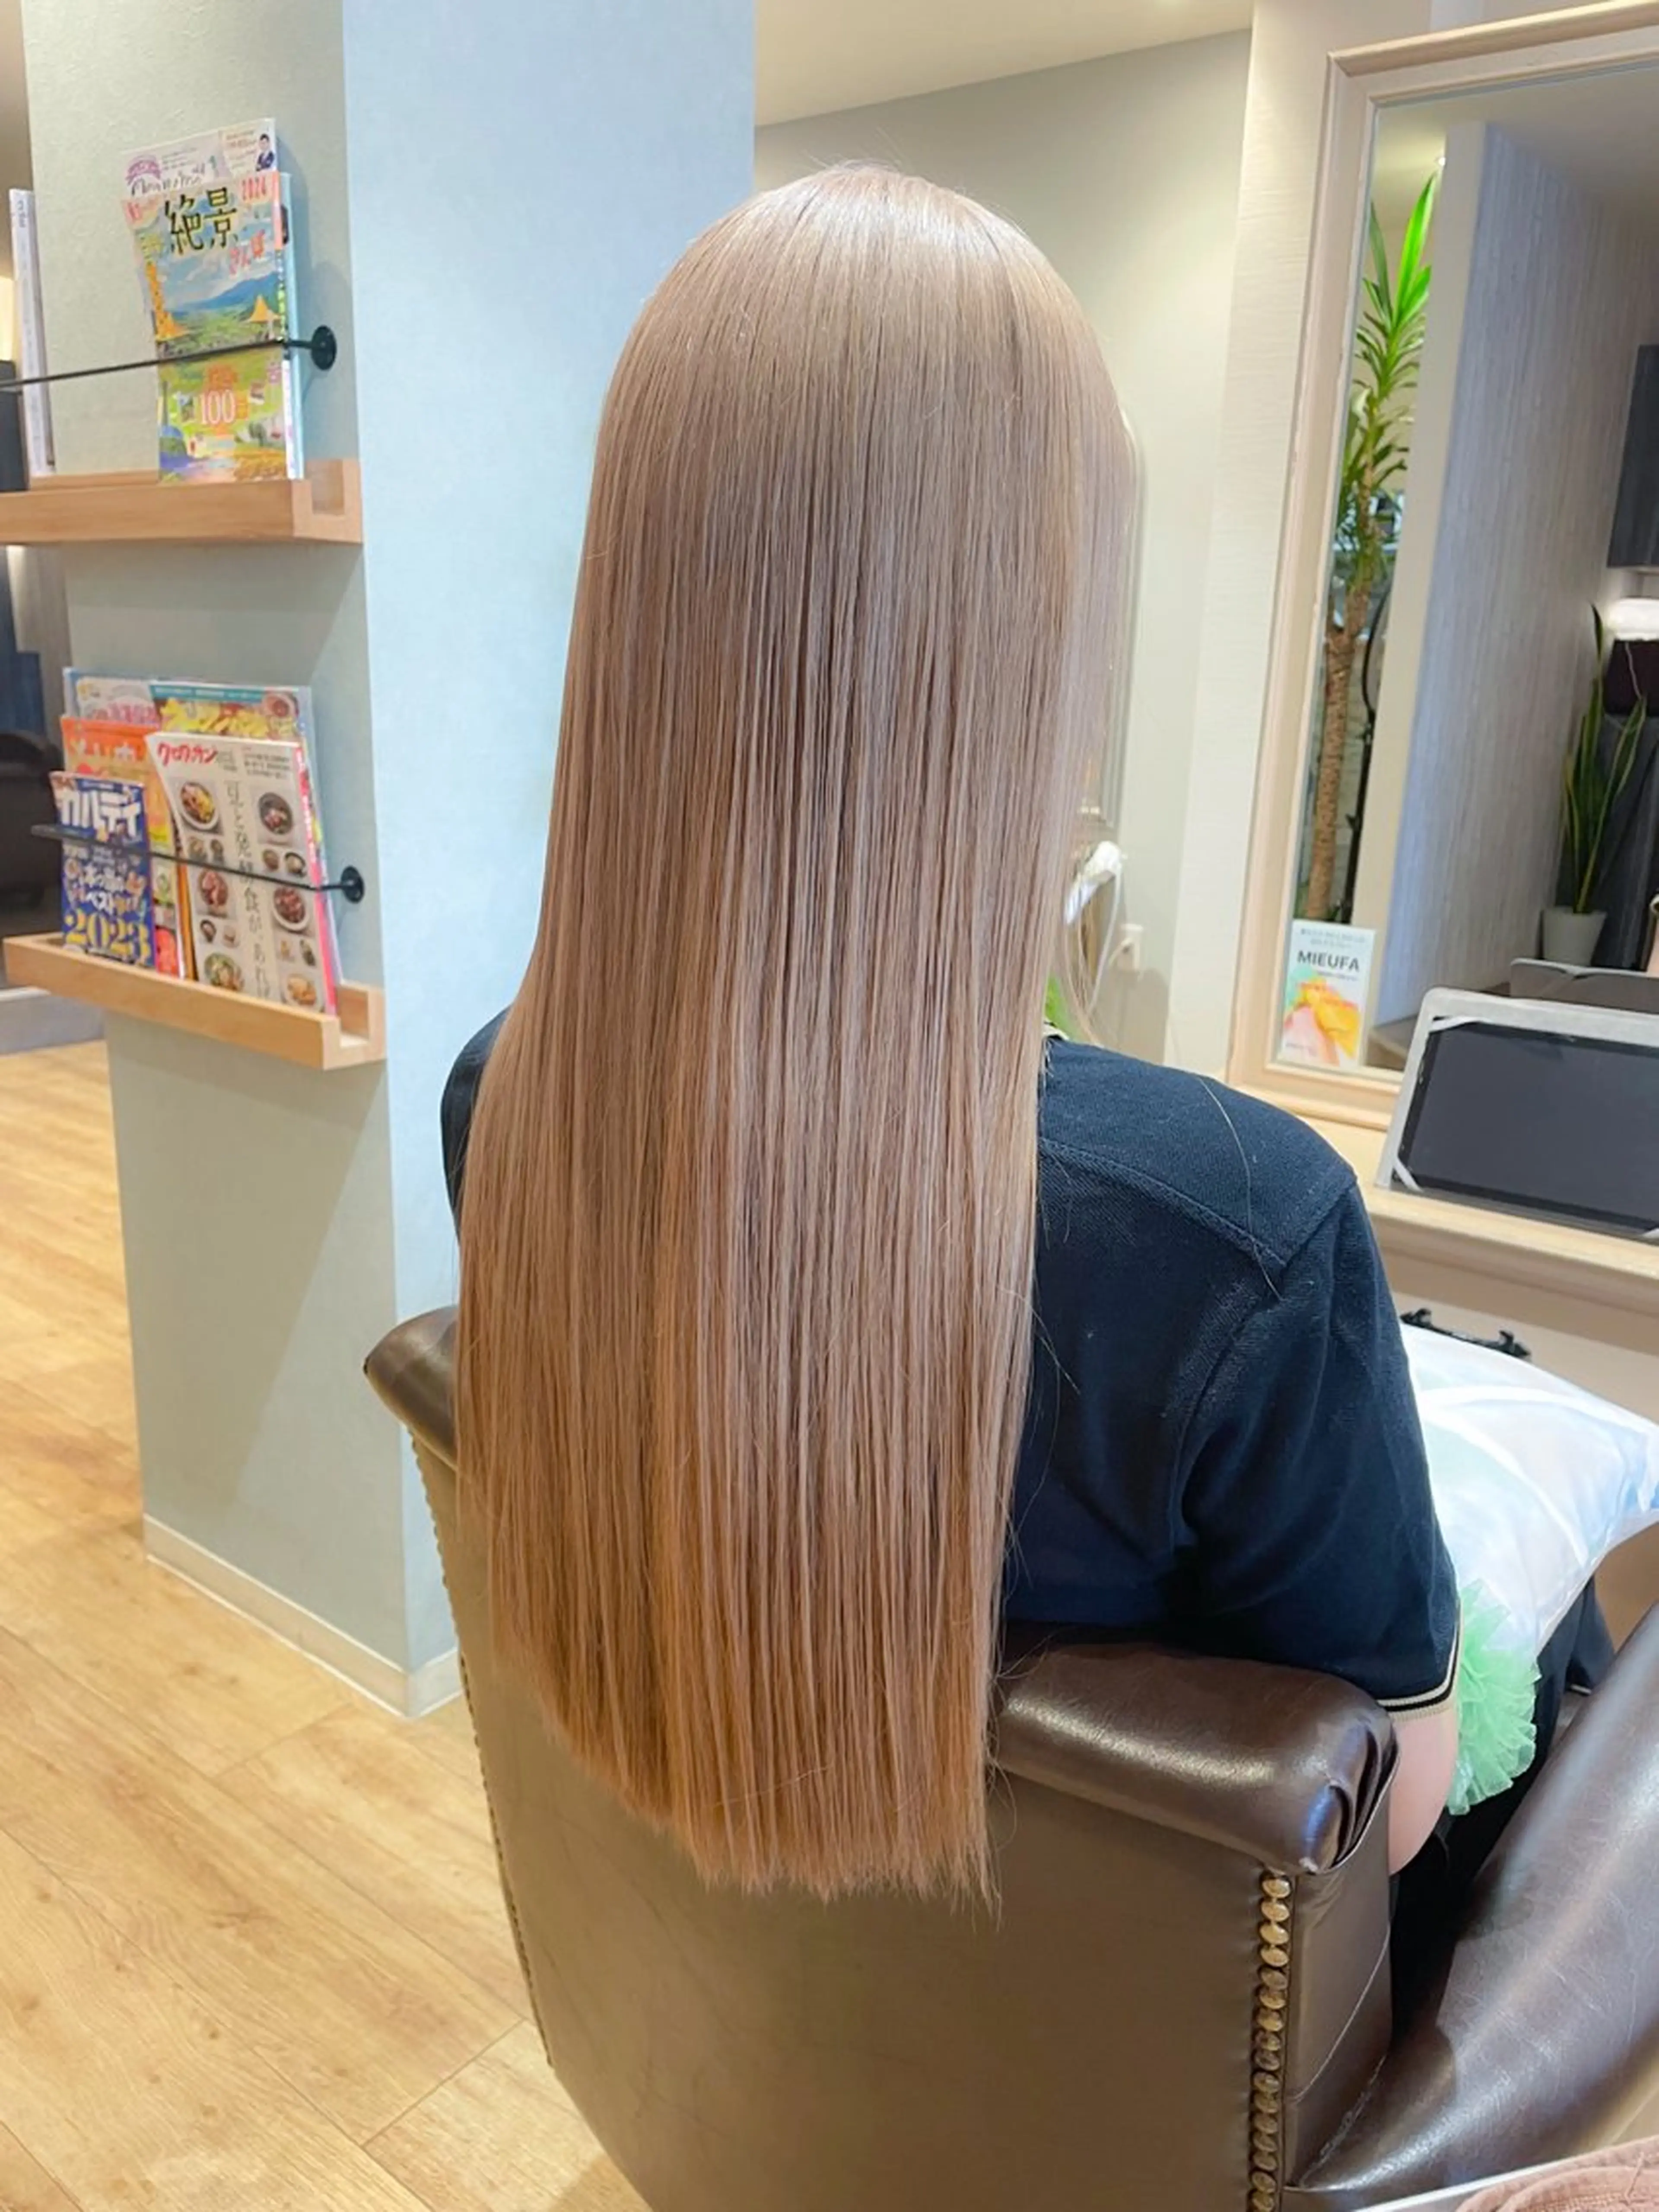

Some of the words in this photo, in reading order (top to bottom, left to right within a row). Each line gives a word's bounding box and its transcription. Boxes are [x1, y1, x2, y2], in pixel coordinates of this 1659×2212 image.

[200, 389, 235, 425] 100
[59, 790, 141, 838] カルディ
[65, 908, 150, 963] 2023
[1297, 950, 1360, 971] MIEUFA
